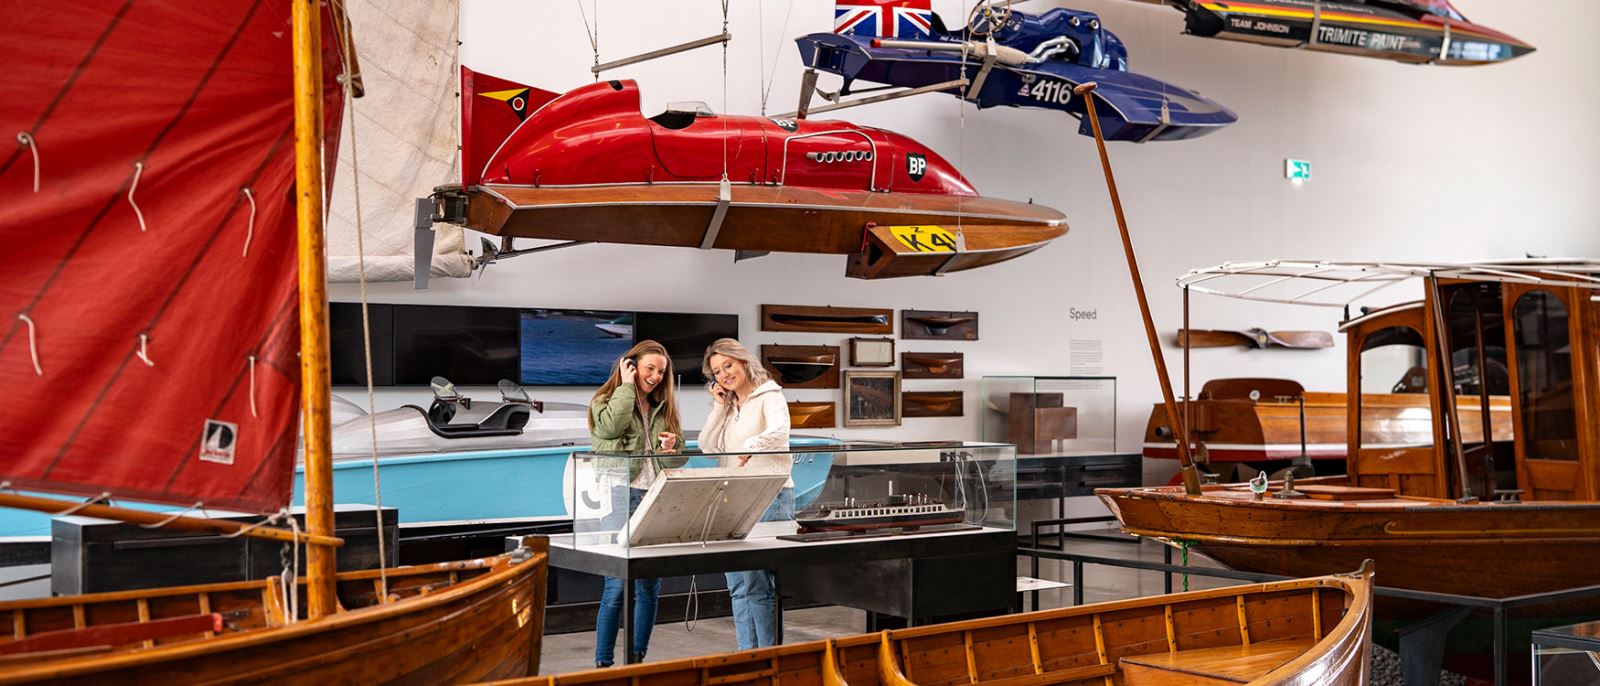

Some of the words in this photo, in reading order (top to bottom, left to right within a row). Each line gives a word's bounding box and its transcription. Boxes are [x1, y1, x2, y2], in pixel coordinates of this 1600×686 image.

[1231, 18, 1252, 29] TEAM
[1254, 21, 1290, 33] JOHNSON
[1319, 27, 1368, 46] TRIMITE
[1031, 80, 1073, 104] 4116
[771, 118, 796, 128] BP
[908, 156, 926, 175] BP
[900, 234, 935, 252] K
[1069, 307, 1097, 322] Speed
